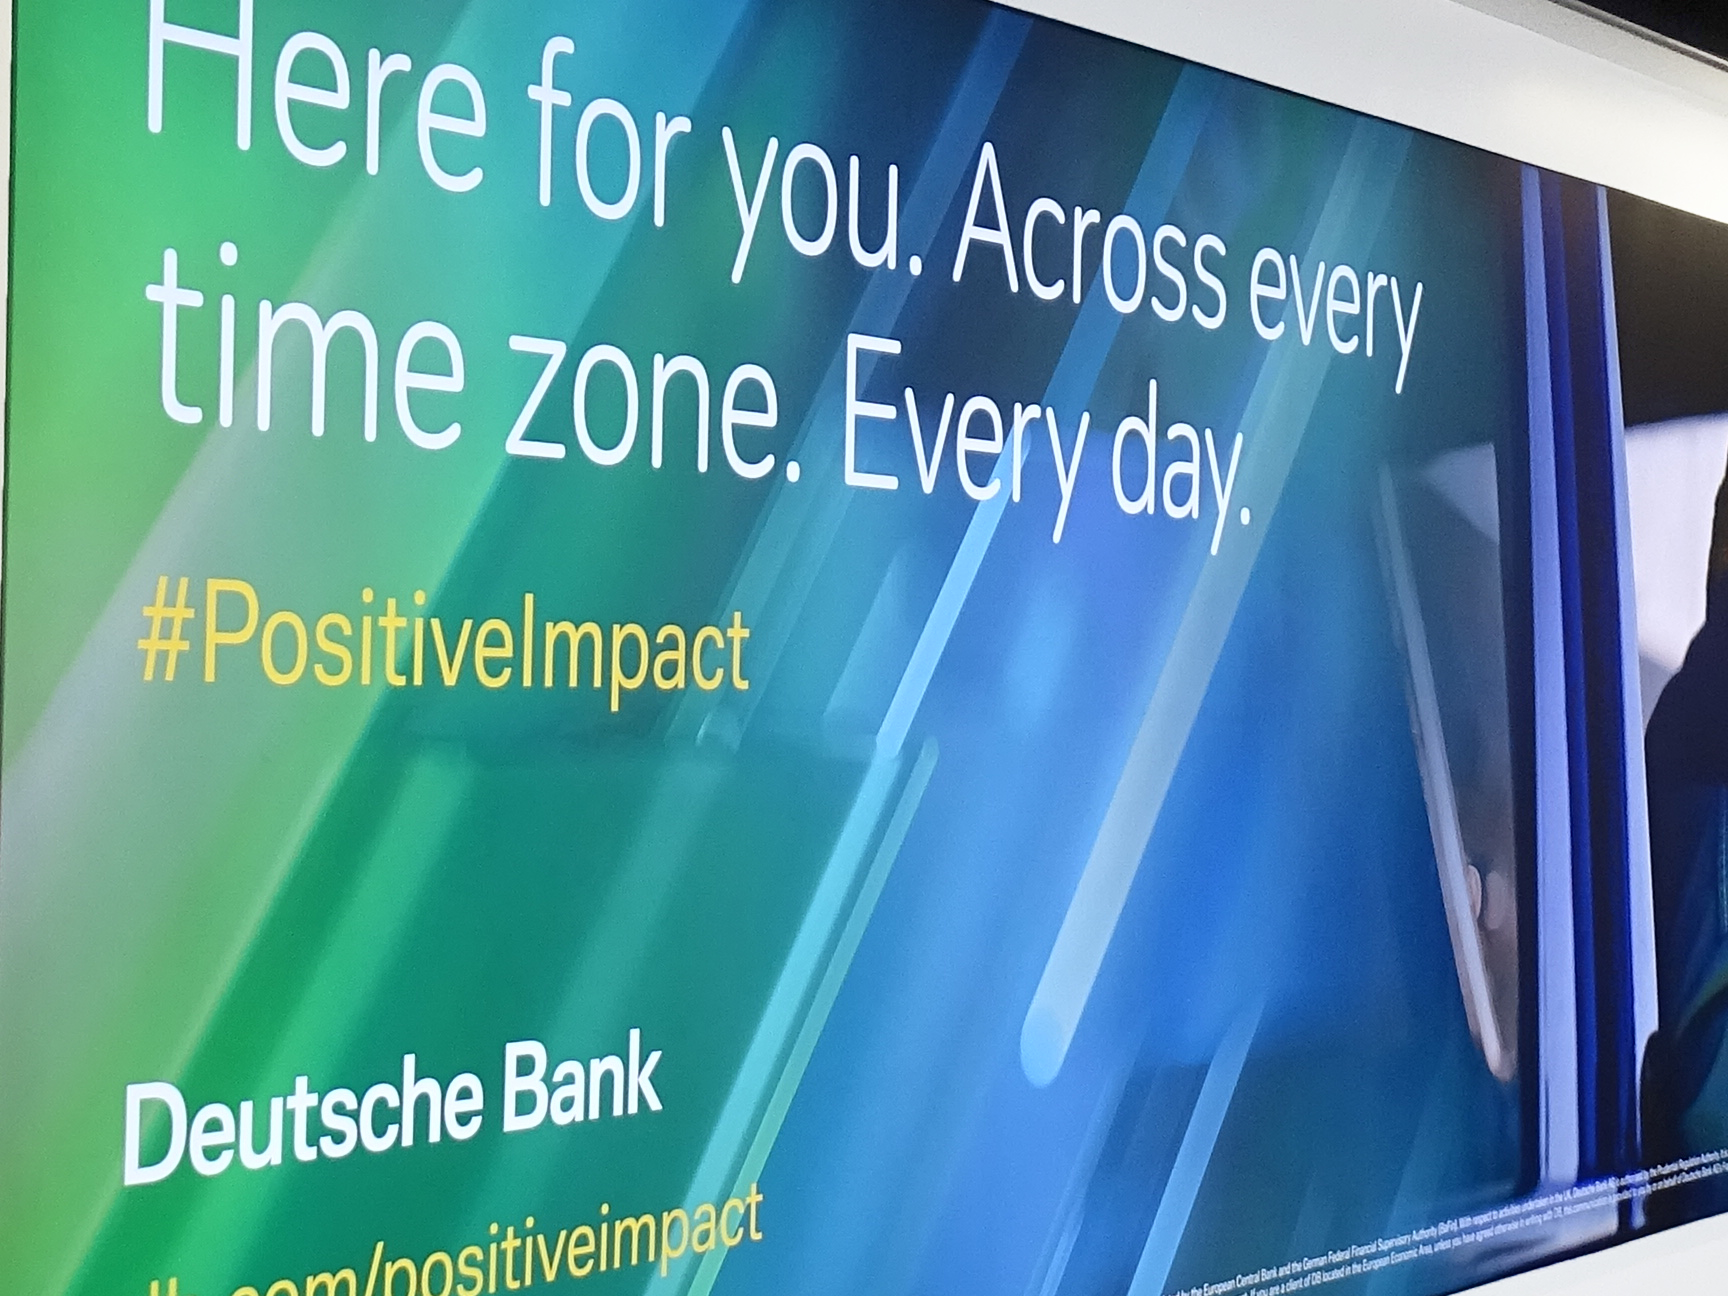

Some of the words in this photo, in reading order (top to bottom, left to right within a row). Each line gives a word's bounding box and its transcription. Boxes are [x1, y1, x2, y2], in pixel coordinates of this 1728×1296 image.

[525, 29, 690, 233] for
[731, 124, 922, 290] you.
[952, 133, 1227, 331] Across
[1248, 241, 1422, 396] every
[144, 228, 465, 453] time
[507, 331, 800, 484] zone.
[843, 335, 1091, 545] Every
[1110, 376, 1252, 556] day.
[137, 578, 750, 710] #PositiveImpact
[121, 1048, 485, 1189] Deutsche
[501, 1023, 665, 1134] Bank
